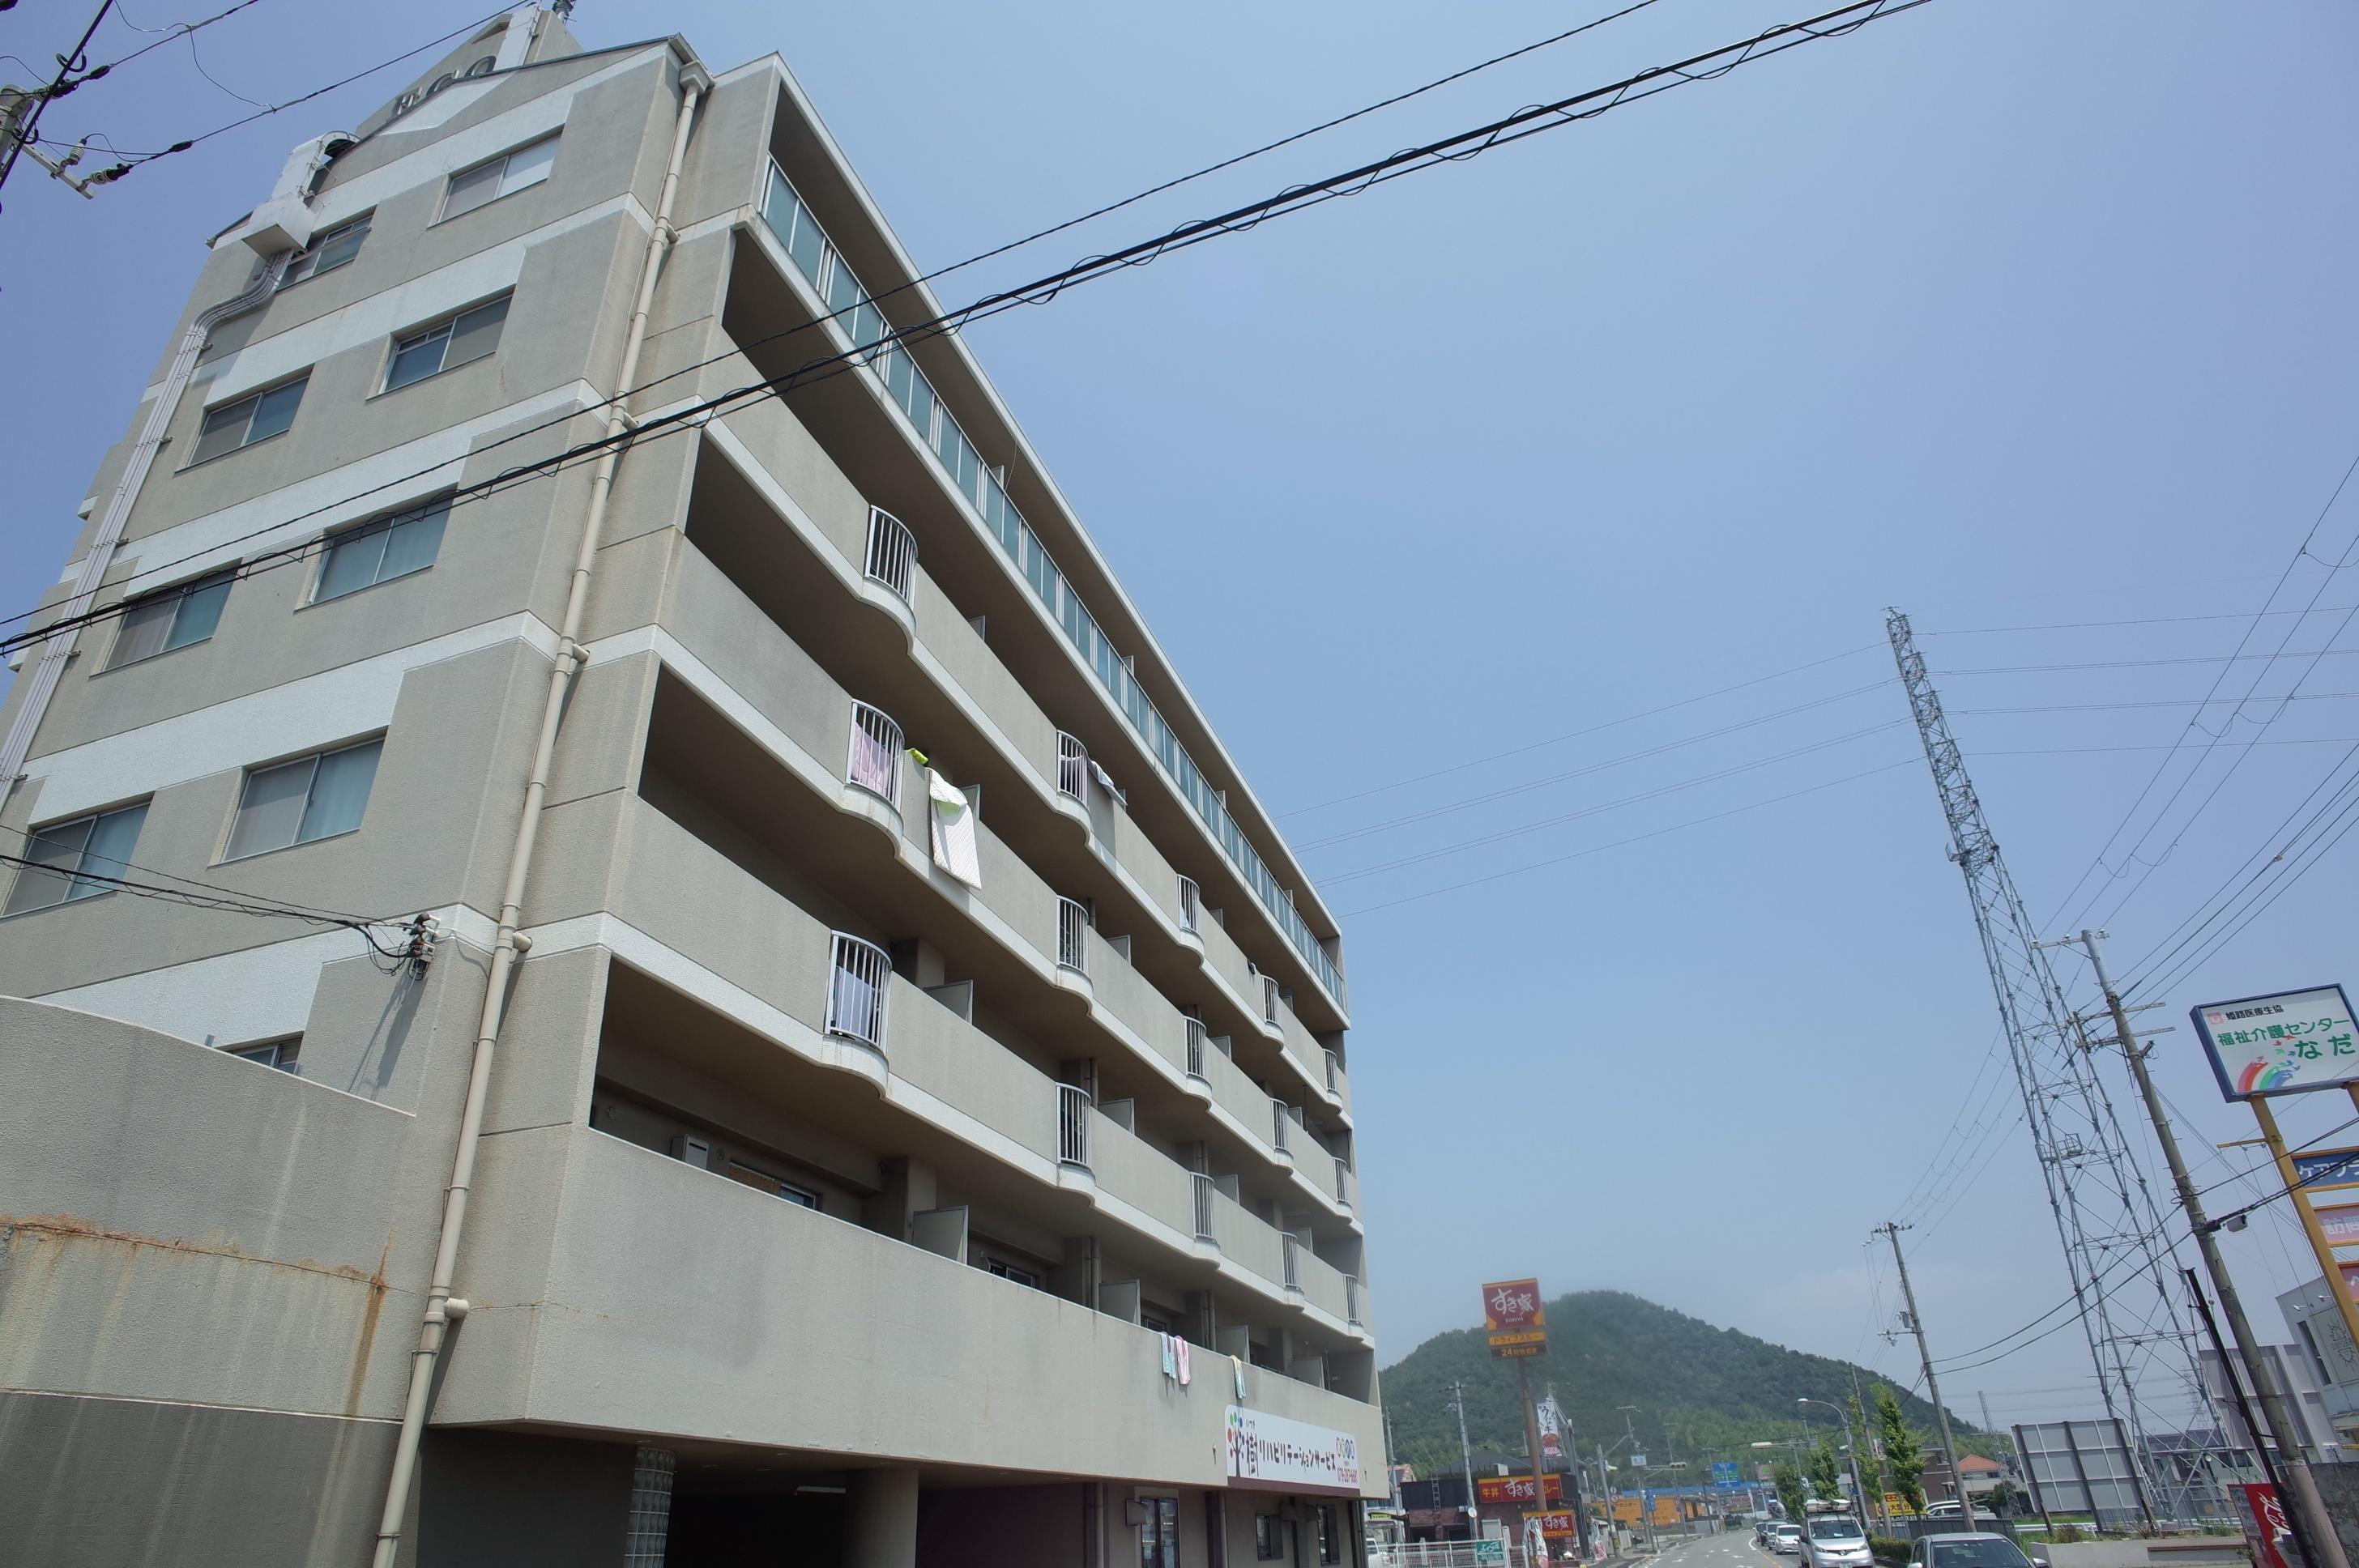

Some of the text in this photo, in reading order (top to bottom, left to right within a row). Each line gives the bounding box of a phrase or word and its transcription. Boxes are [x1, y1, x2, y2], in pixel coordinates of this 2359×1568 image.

[2225, 1004, 2284, 1020] 姫路医療生協
[2217, 1017, 2350, 1046] 福祉介護センター
[2294, 1033, 2357, 1059] なだ
[1491, 1288, 1534, 1316] すき家
[1504, 1478, 1535, 1498] すき家
[1543, 1512, 1568, 1530] すき家
